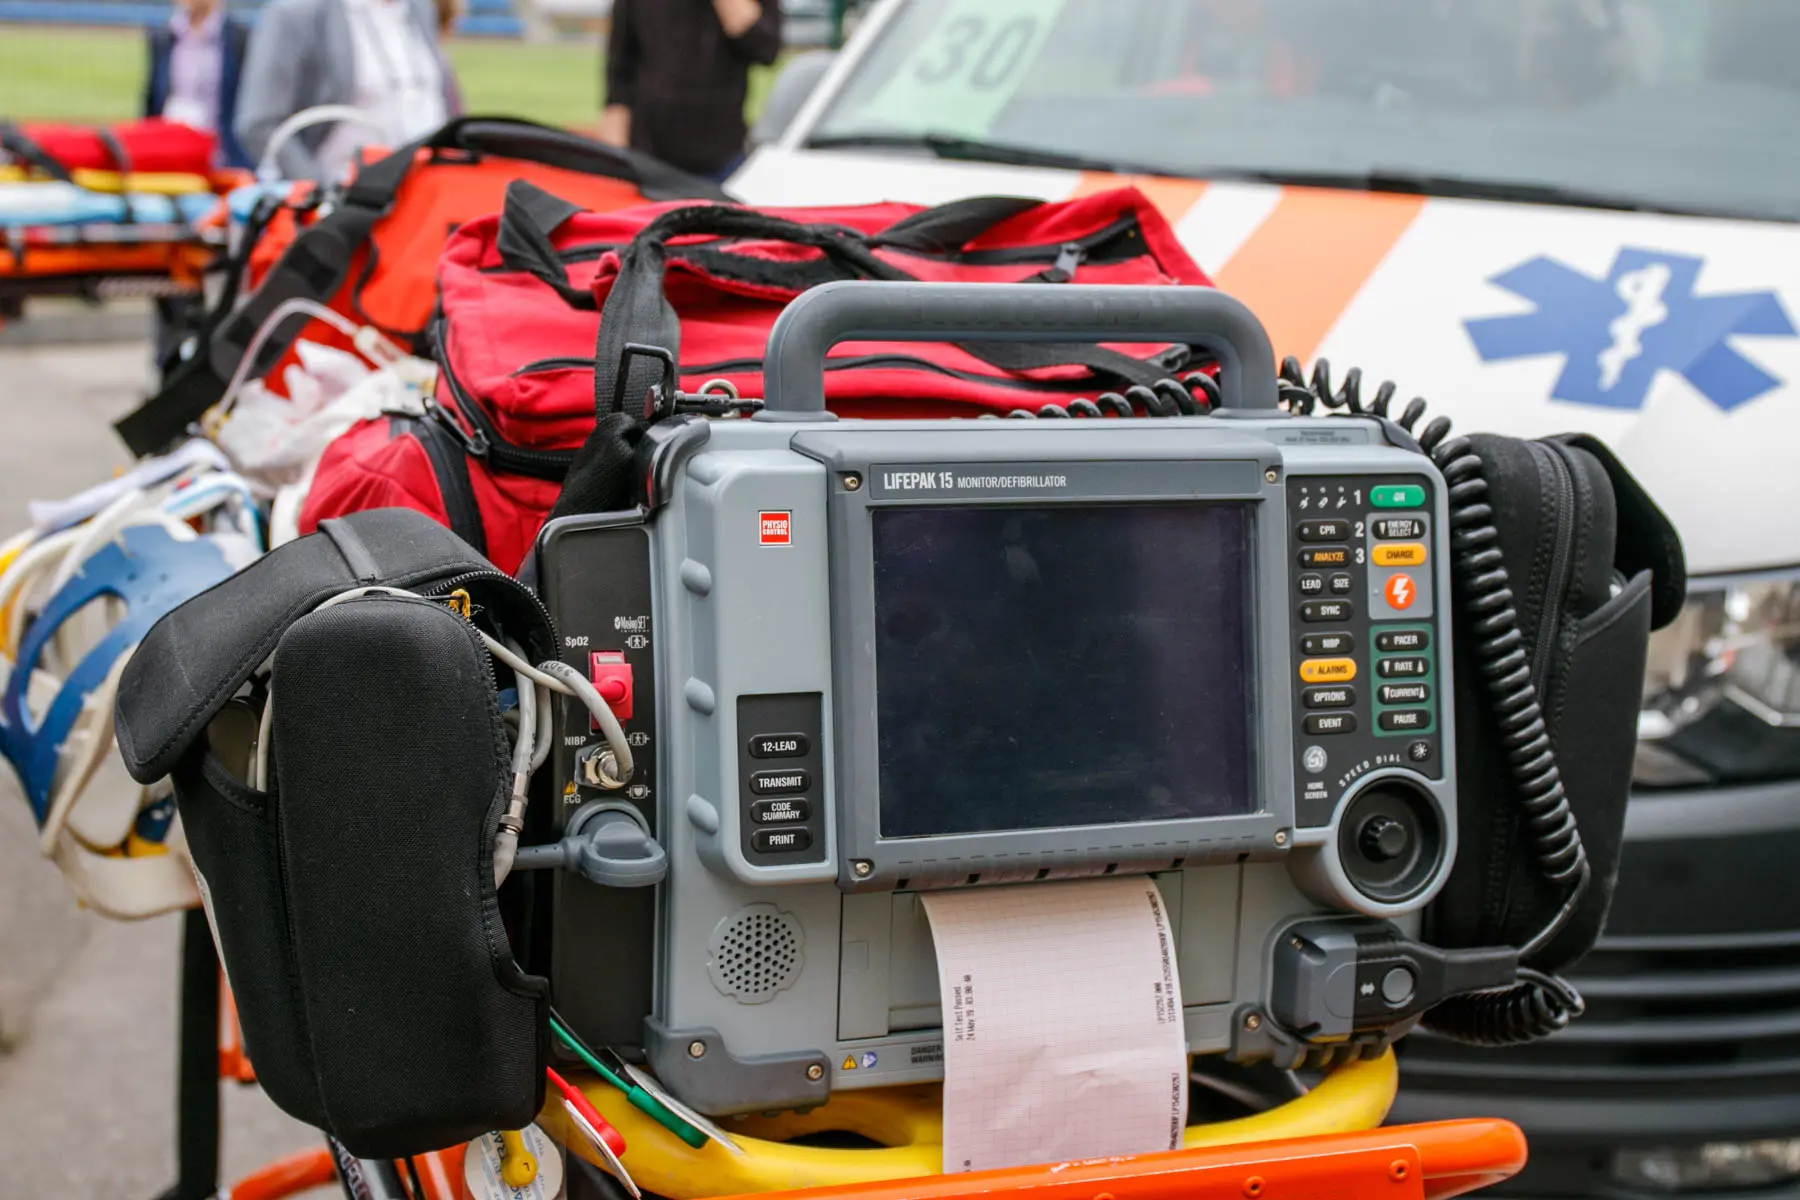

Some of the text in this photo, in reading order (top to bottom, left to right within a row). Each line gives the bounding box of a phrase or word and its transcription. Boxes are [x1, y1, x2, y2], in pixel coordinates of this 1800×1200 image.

[914, 15, 1038, 91] 30
[883, 472, 1067, 490] LIFEPAK 15 MONITOR/DEFIBRILLATOR
[1353, 489, 1362, 506] 1
[1392, 492, 1406, 503] ON
[1354, 521, 1365, 538] 2
[1387, 520, 1413, 528] ENERGY
[1319, 525, 1336, 535] CPR
[1388, 528, 1412, 537] SELECT
[1313, 551, 1345, 562] ANALYZE
[1355, 547, 1365, 564] 3
[1386, 550, 1414, 559] CHARGE
[1301, 579, 1322, 589] LEAD
[1333, 578, 1350, 588] SIZE
[1320, 605, 1341, 616] SYNC
[565, 636, 589, 648] SpO2
[1322, 638, 1340, 649] NIBP
[1393, 635, 1418, 645] PACER
[1317, 665, 1347, 675] ALARMS
[1394, 661, 1413, 671] RATE
[1314, 691, 1346, 702] OPTIONS
[1389, 687, 1419, 698] CURRENT
[1318, 718, 1342, 729] EVENT
[1393, 714, 1417, 724] PAUSE
[564, 736, 587, 746] NIBP
[762, 741, 797, 752] 12-LEAD
[1338, 753, 1401, 787] SPEED DIAL
[758, 776, 803, 788] TRANSMIT
[1307, 781, 1324, 790] HOME
[563, 794, 581, 804] ECG
[1304, 790, 1328, 800] SCREEN
[771, 803, 792, 811] CODE
[762, 810, 800, 821] SUMMARY
[769, 834, 796, 845] PRINT
[953, 986, 963, 1009] Passed
[954, 1011, 963, 1025] Test
